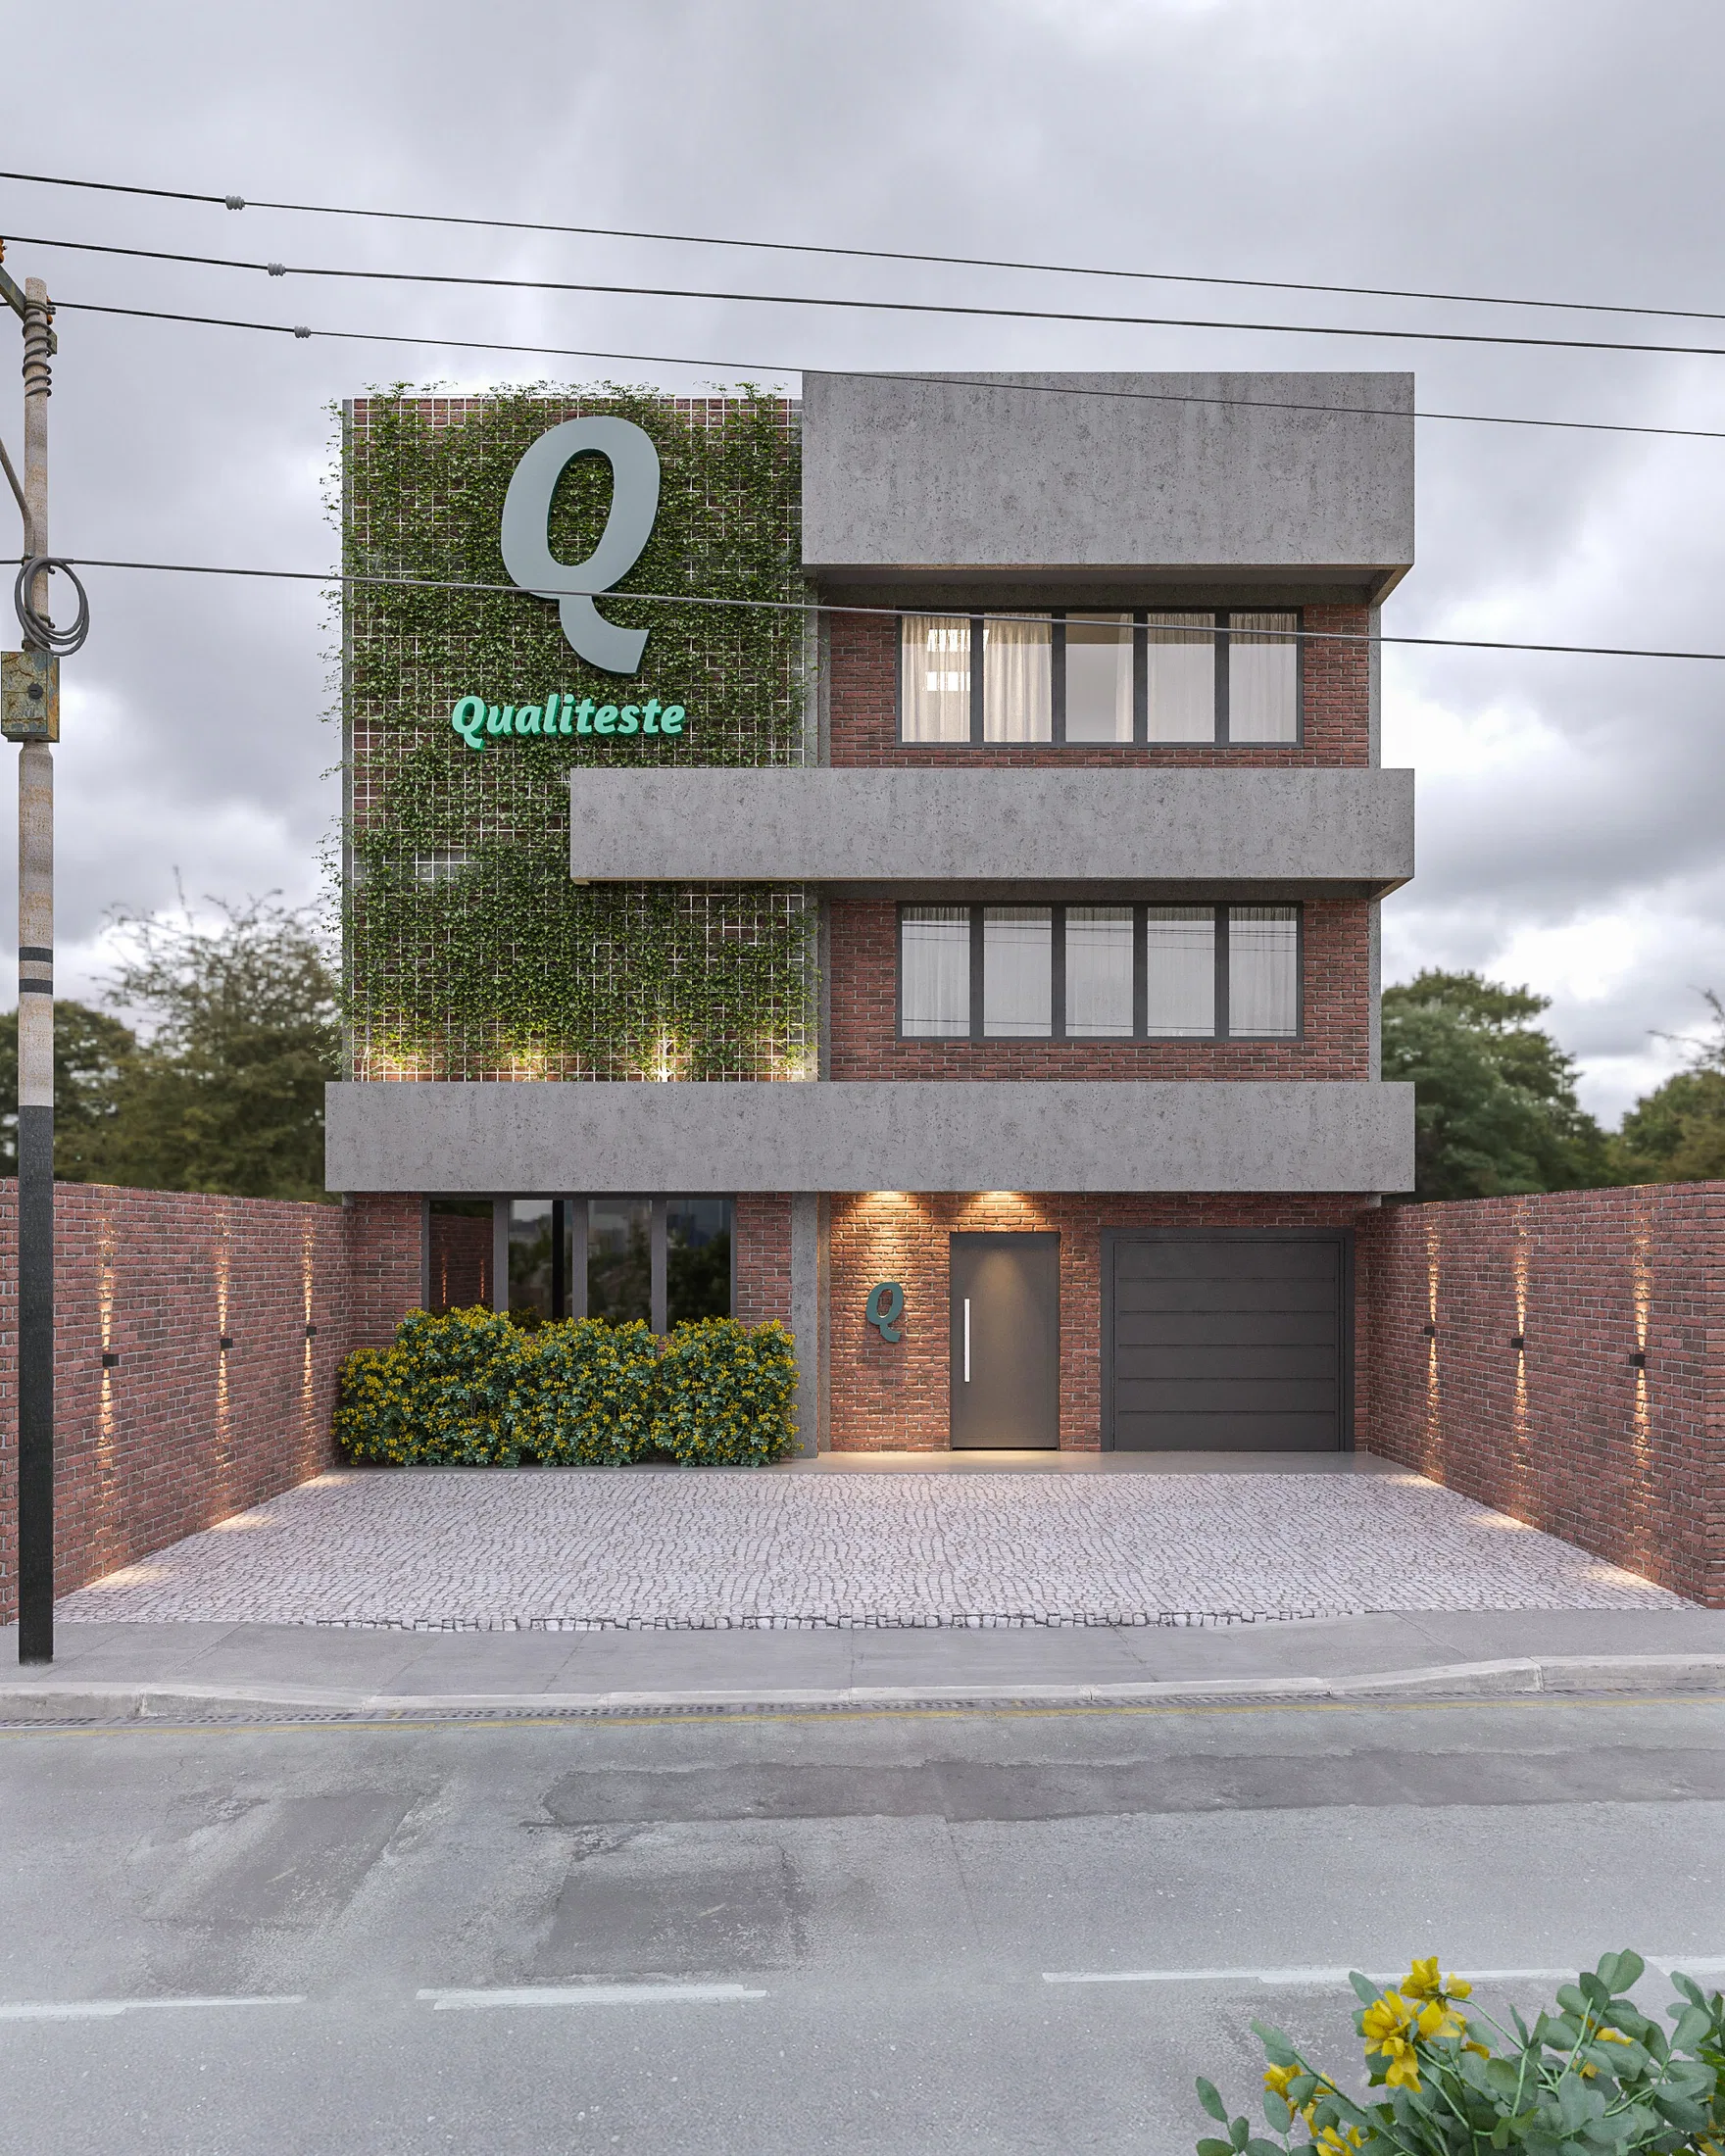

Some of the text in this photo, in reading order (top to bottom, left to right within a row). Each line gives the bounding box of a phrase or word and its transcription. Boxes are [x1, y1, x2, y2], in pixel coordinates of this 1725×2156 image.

[502, 416, 661, 673] Q
[452, 694, 685, 750] Qualiteste
[866, 1282, 904, 1343] Q
